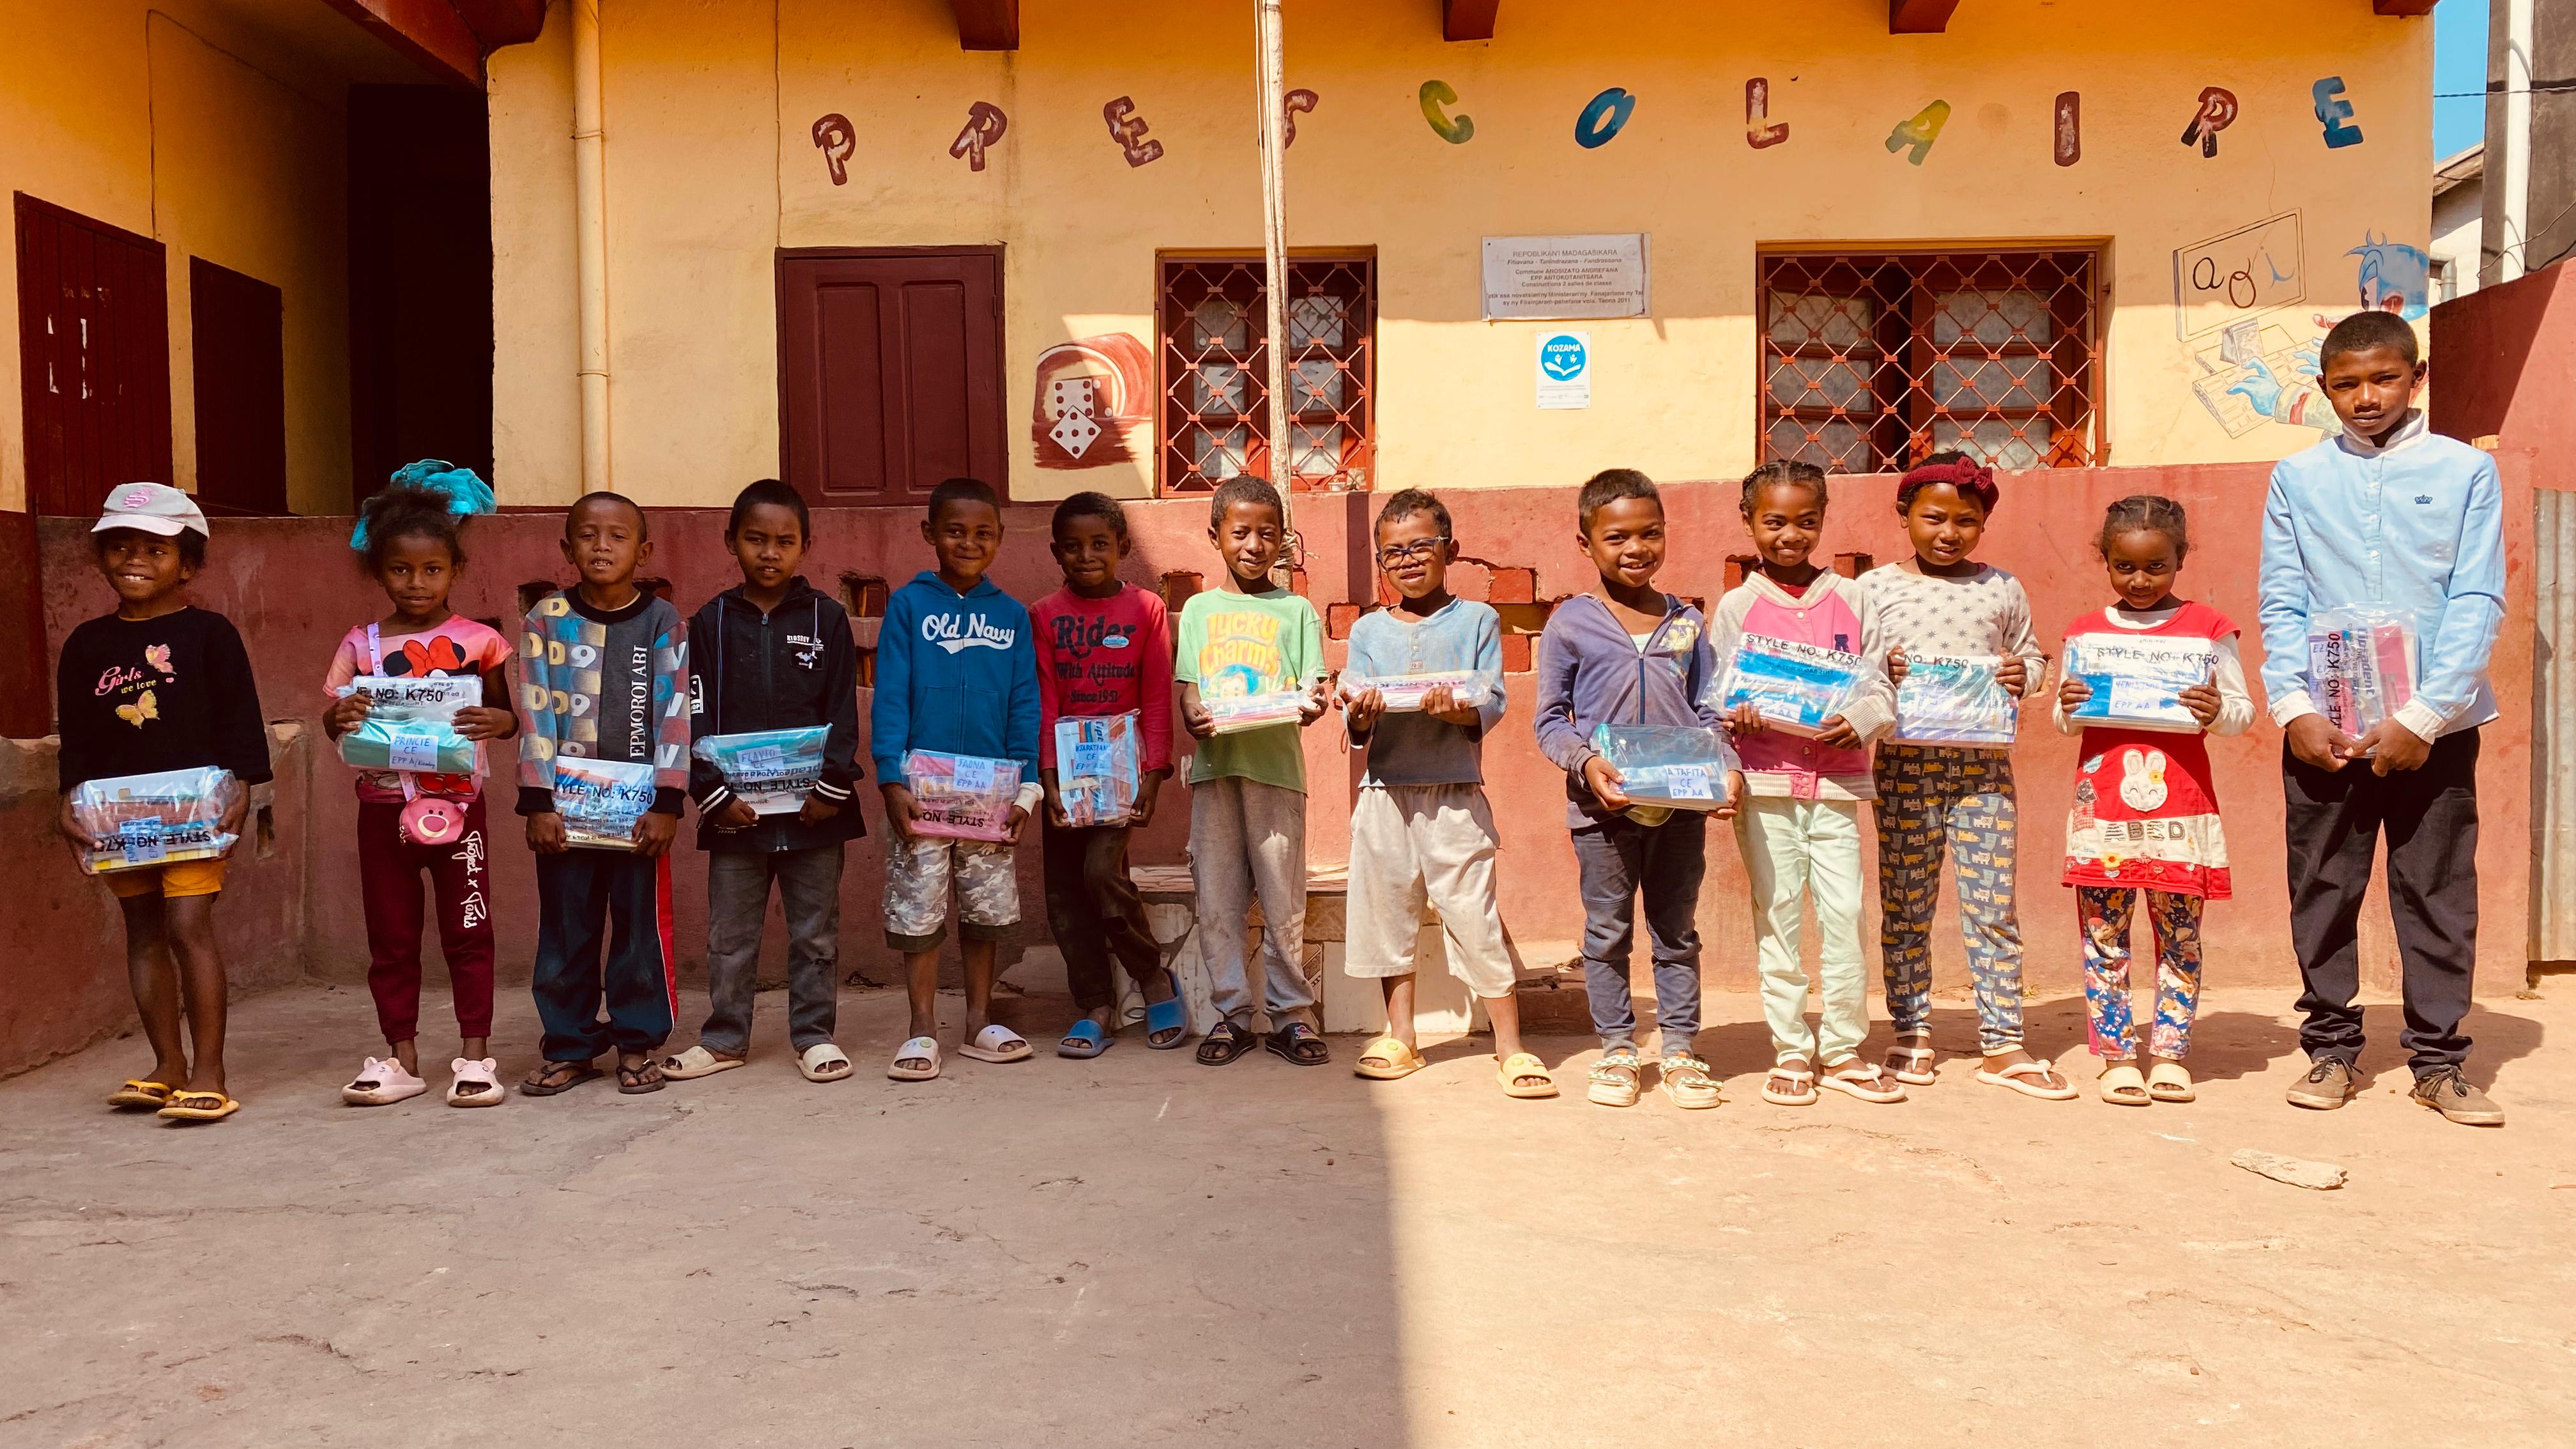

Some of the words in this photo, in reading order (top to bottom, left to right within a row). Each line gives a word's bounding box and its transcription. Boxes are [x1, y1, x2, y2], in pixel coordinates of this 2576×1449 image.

[1547, 344, 1581, 353] KOZAMA
[922, 613, 960, 641] Old
[964, 613, 1015, 645] Navy
[1051, 615, 1136, 659] Rider
[1747, 634, 1789, 650] STYLE
[2097, 647, 2142, 659] STYLE
[2328, 633, 2341, 669] K750
[1933, 656, 1969, 669] K750
[95, 666, 142, 696] Girls
[1056, 662, 1083, 679] With
[1087, 661, 1135, 687] Attitude
[121, 684, 134, 694] we
[136, 679, 157, 690] love
[2327, 675, 2340, 698] NO:
[375, 688, 399, 700] NO:
[406, 688, 443, 702] K750
[404, 746, 418, 755] CE
[392, 756, 408, 764] EPP
[770, 778, 810, 792] STYLE
[957, 779, 972, 788] EPP
[974, 781, 986, 789] AA
[1680, 778, 1692, 788] CE
[554, 783, 585, 795] TYLE
[592, 786, 615, 799] NO:
[621, 788, 653, 804] K750
[1673, 788, 1687, 797] EPP
[1692, 788, 1704, 797] AA
[948, 814, 985, 827] STYLE
[100, 838, 126, 852] K7
[165, 830, 211, 846] STYLE
[451, 831, 484, 876] Project
[460, 891, 486, 928] Paris
